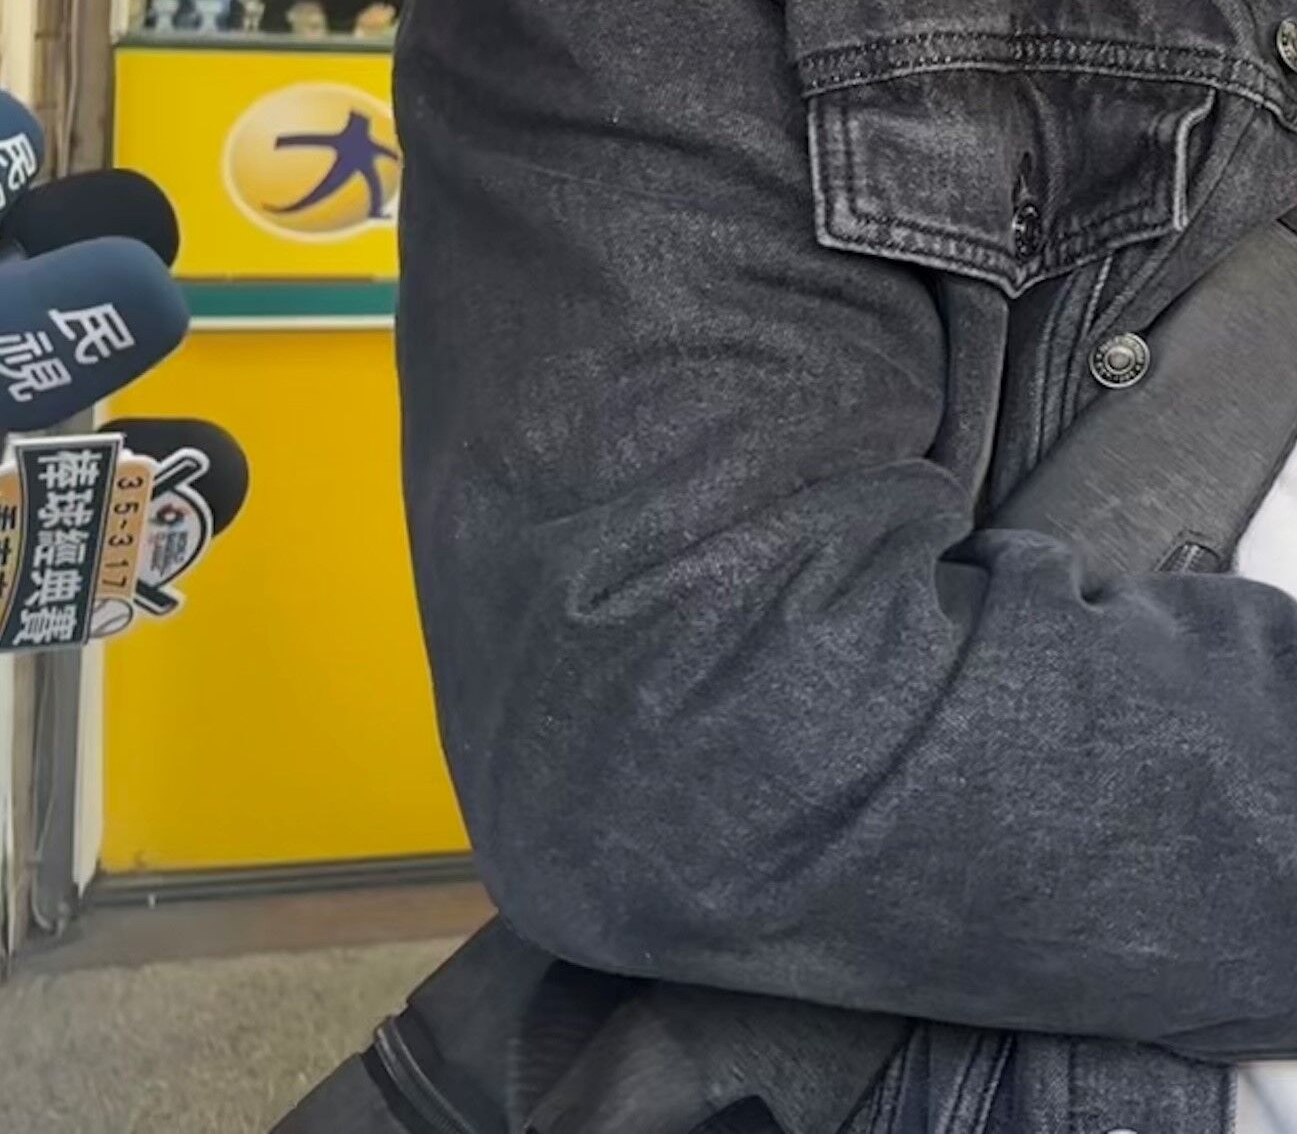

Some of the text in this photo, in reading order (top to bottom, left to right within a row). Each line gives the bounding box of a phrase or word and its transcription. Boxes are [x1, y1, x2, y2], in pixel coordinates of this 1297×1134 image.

[0, 301, 137, 403] 民視
[12, 448, 103, 646] 棒球經典賽
